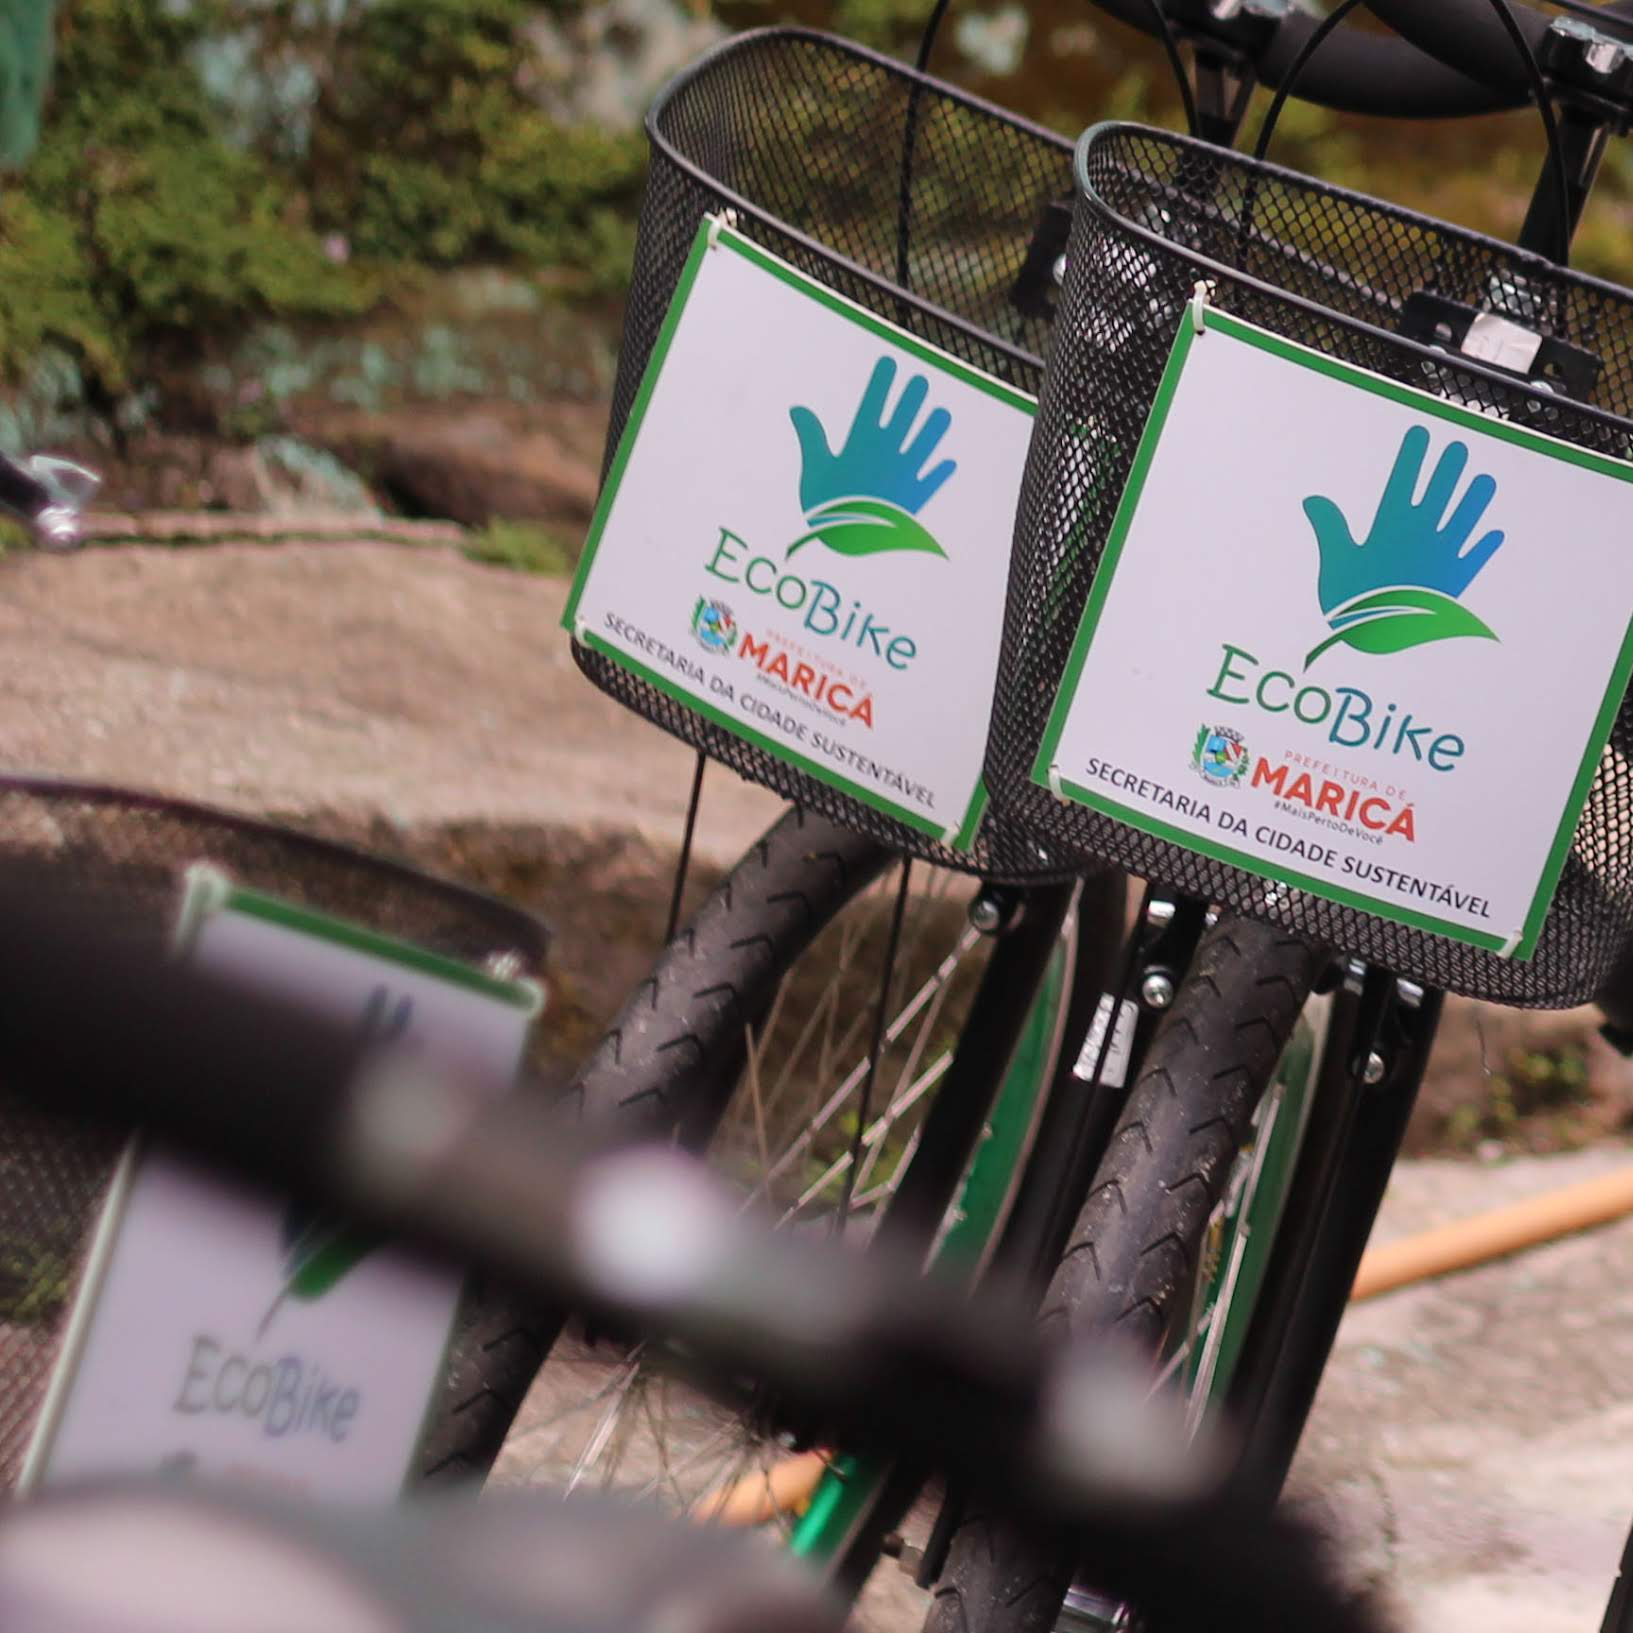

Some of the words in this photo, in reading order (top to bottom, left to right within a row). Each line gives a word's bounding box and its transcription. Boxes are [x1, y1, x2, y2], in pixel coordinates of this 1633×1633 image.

[704, 526, 918, 671] EcoBike
[604, 611, 705, 685] SECRETARIA
[710, 675, 734, 702] DA
[740, 694, 808, 741] CIDADE
[1206, 643, 1466, 772] EcoBike
[1086, 758, 1211, 823] SECRETARIA
[1217, 811, 1248, 837] DA
[1255, 825, 1338, 868] CIDADE
[1341, 855, 1491, 918] SUSTENTÁVEL
[1251, 756, 1416, 843] MARICÁ
[1285, 750, 1378, 791] PREFEITURA
[1386, 785, 1407, 800] DE
[172, 1333, 363, 1445] EcoBike
